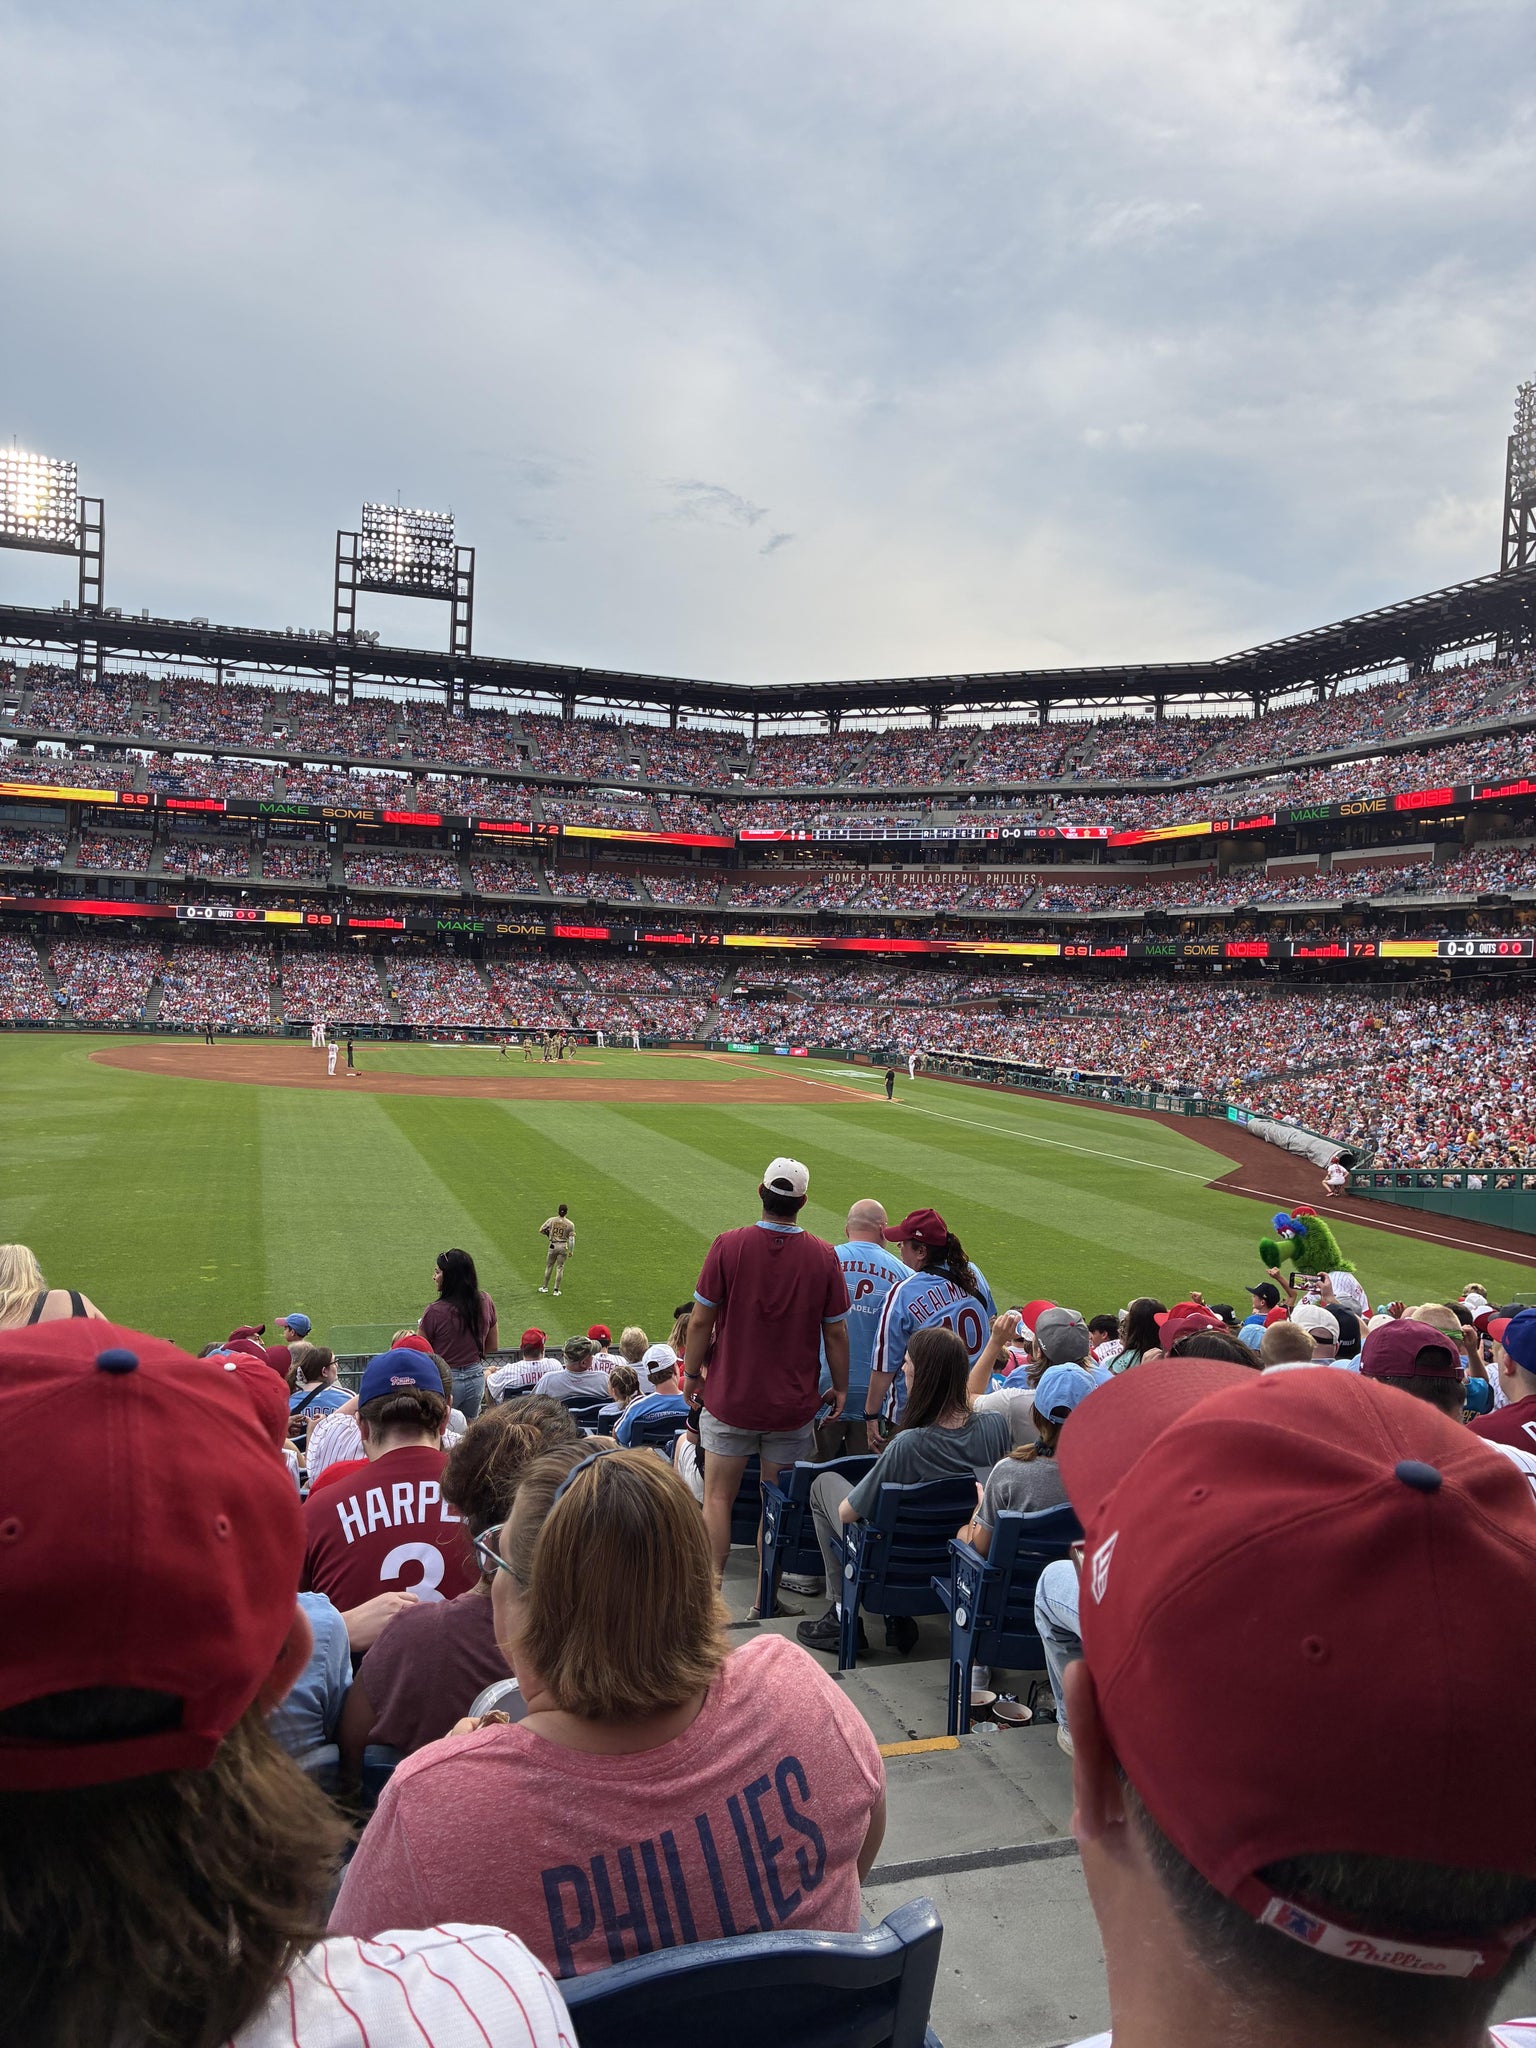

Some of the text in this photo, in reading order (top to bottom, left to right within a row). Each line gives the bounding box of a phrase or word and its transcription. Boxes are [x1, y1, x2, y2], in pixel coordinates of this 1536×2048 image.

[121, 793, 149, 804] 8.9
[1396, 787, 1454, 811] NOISE
[259, 803, 441, 826] MAKE SOME NOISE
[1290, 798, 1387, 822] MAKE SOME
[537, 824, 559, 835] 7.2
[1002, 829, 1021, 837] 0-0
[1099, 828, 1108, 836] 10
[828, 872, 856, 883] HOME
[879, 873, 897, 883] THE
[903, 873, 973, 884] PHILADELPHI
[986, 873, 1036, 884] PHILLIES
[187, 907, 213, 918] 0-0
[218, 910, 234, 918] OUTS
[306, 914, 332, 925] 8.9
[436, 920, 610, 939] MAKE SOME NOISE
[699, 935, 720, 945] 7.2
[1064, 945, 1088, 956] 8.9
[1145, 943, 1269, 957] MAKE SOME NOISE
[1353, 943, 1376, 956] 7.2
[1447, 942, 1475, 956] 0-0
[1479, 943, 1497, 954] OUTS
[553, 1227, 564, 1238] 29
[840, 1260, 901, 1285] HILLIE
[907, 1280, 969, 1326] REALMU
[336, 1480, 465, 1545] HARPE
[380, 1541, 445, 1603] 3
[541, 1755, 827, 1978] PHILLIES
[1345, 1939, 1446, 1971] Phillies
